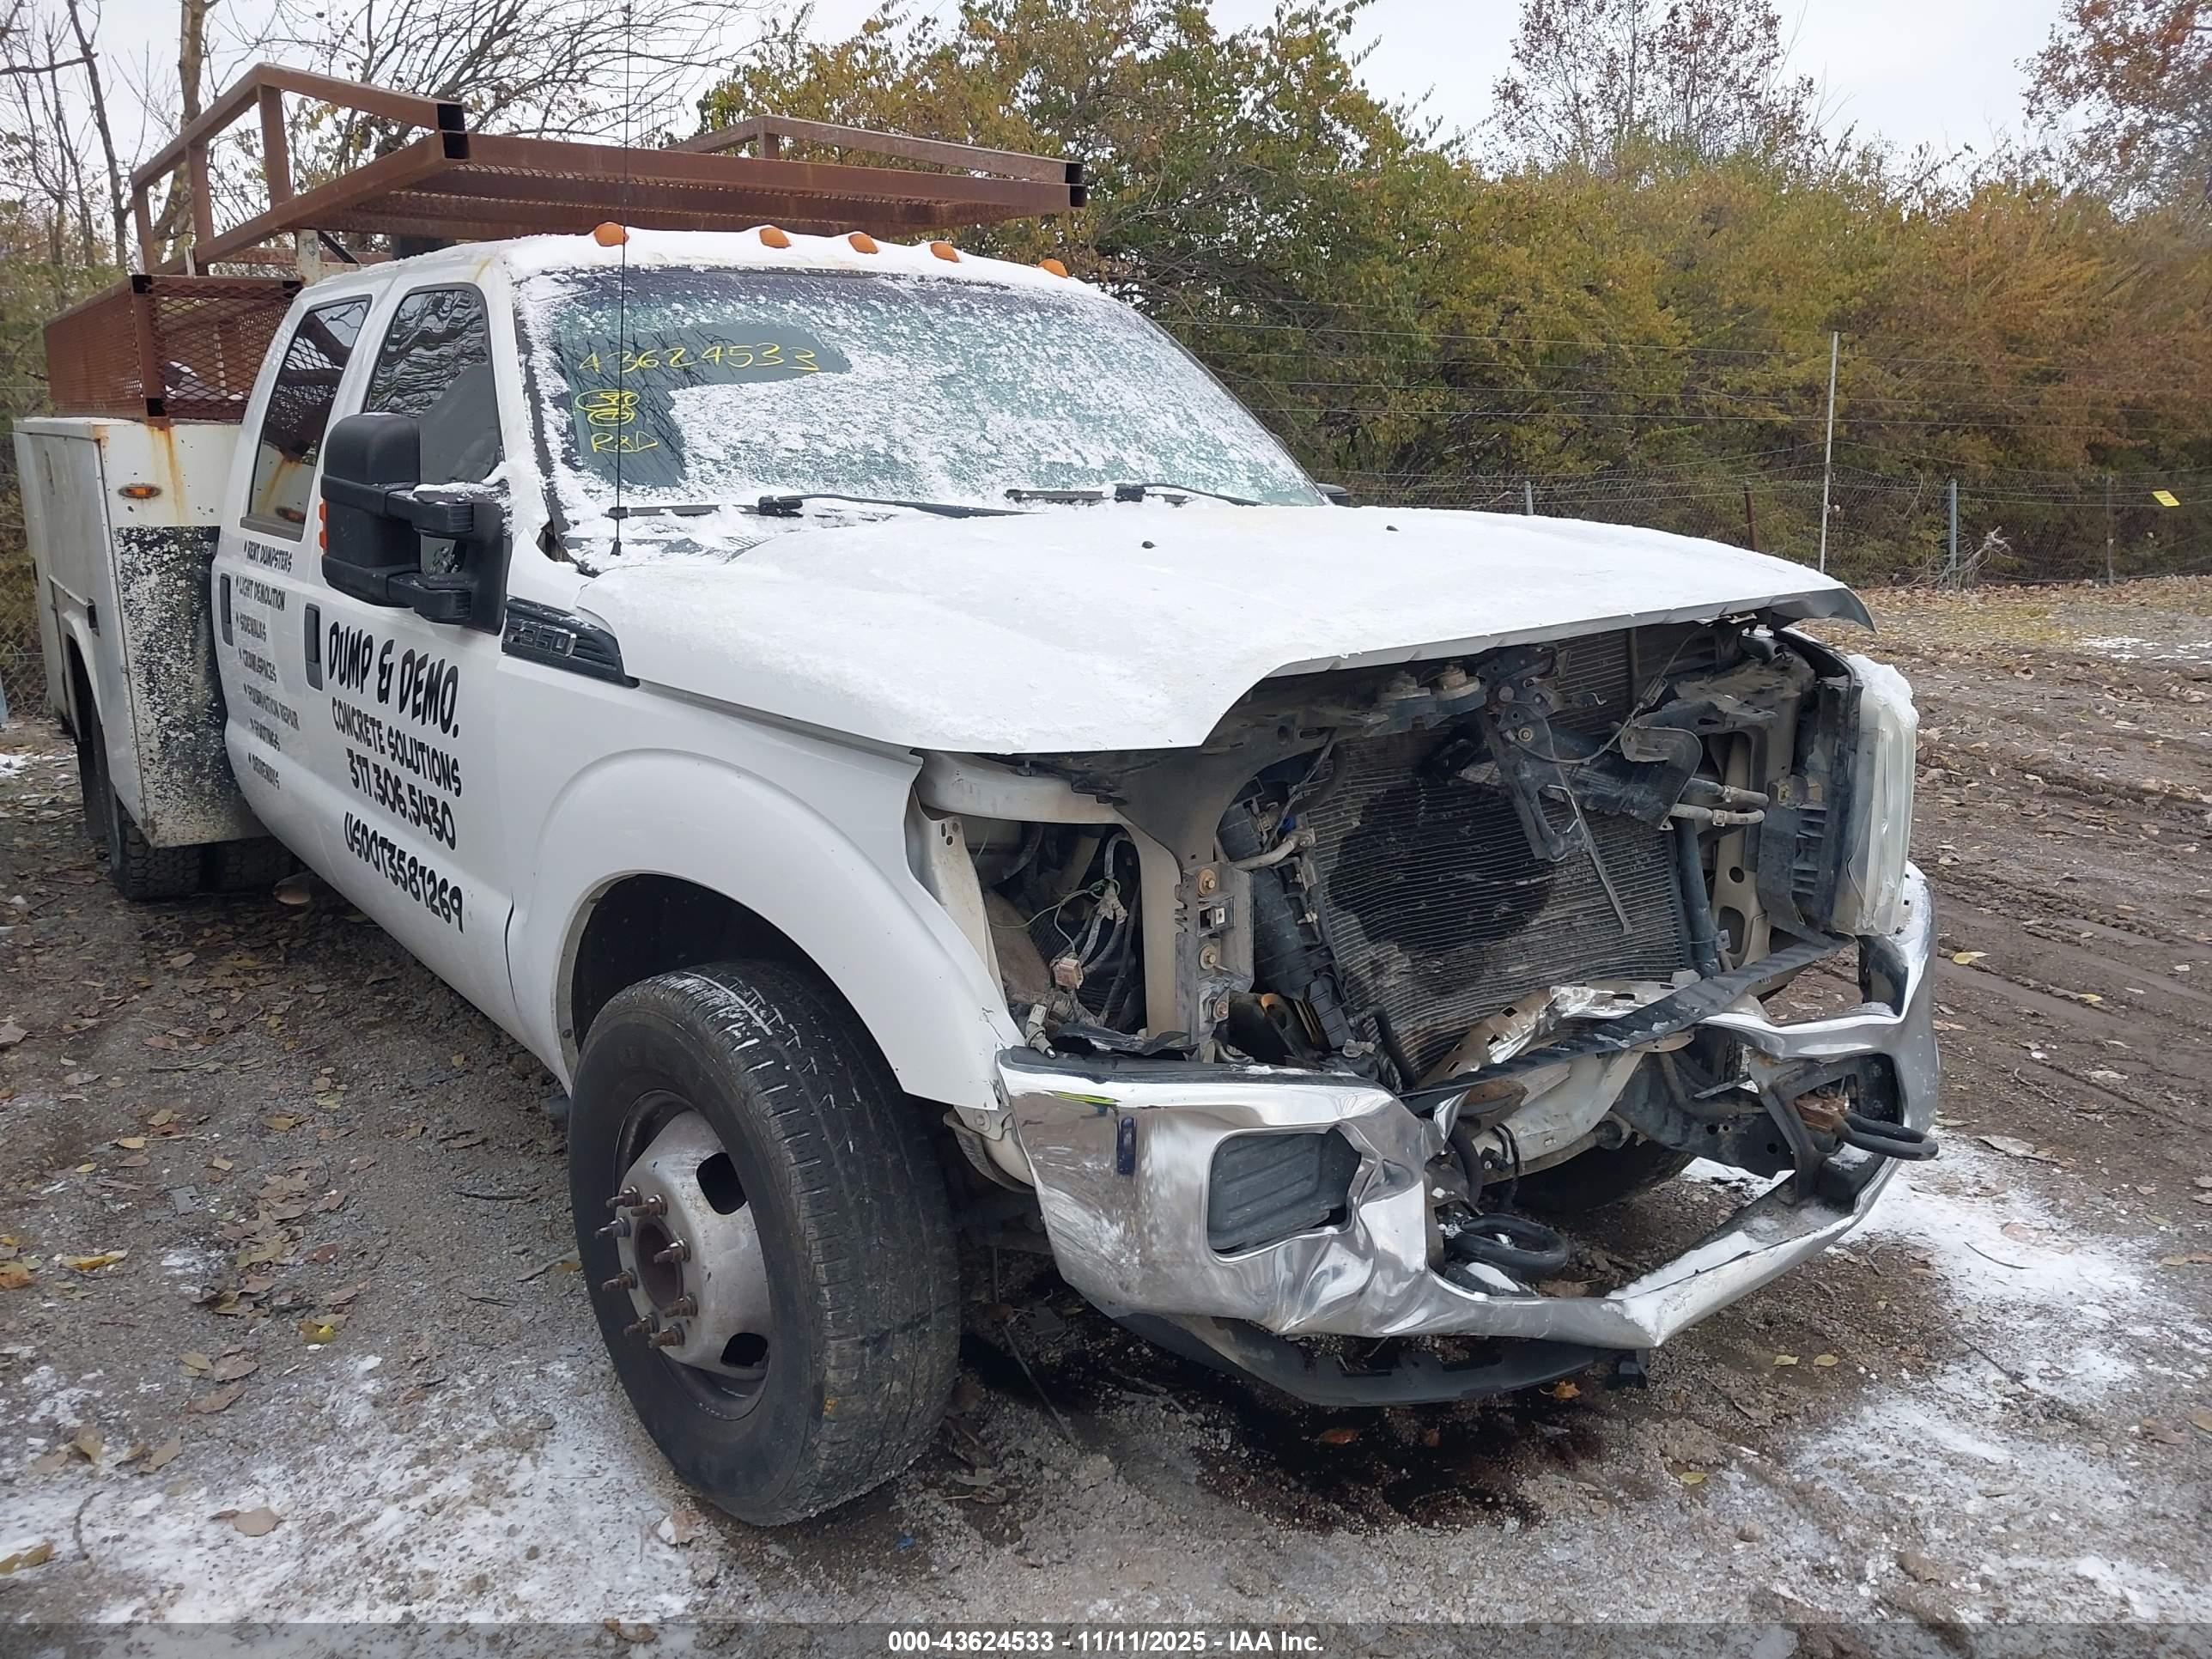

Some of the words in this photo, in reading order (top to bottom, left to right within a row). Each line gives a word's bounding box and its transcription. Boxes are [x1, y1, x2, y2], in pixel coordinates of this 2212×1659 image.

[260, 544, 293, 573] DUMPSTERS
[254, 581, 286, 611] DEMOLITION
[329, 621, 374, 695] DUMP
[377, 638, 395, 705] &
[398, 648, 460, 738] DEMO.
[331, 696, 386, 755] CONCRETE
[387, 725, 462, 798] SOLUTIONS
